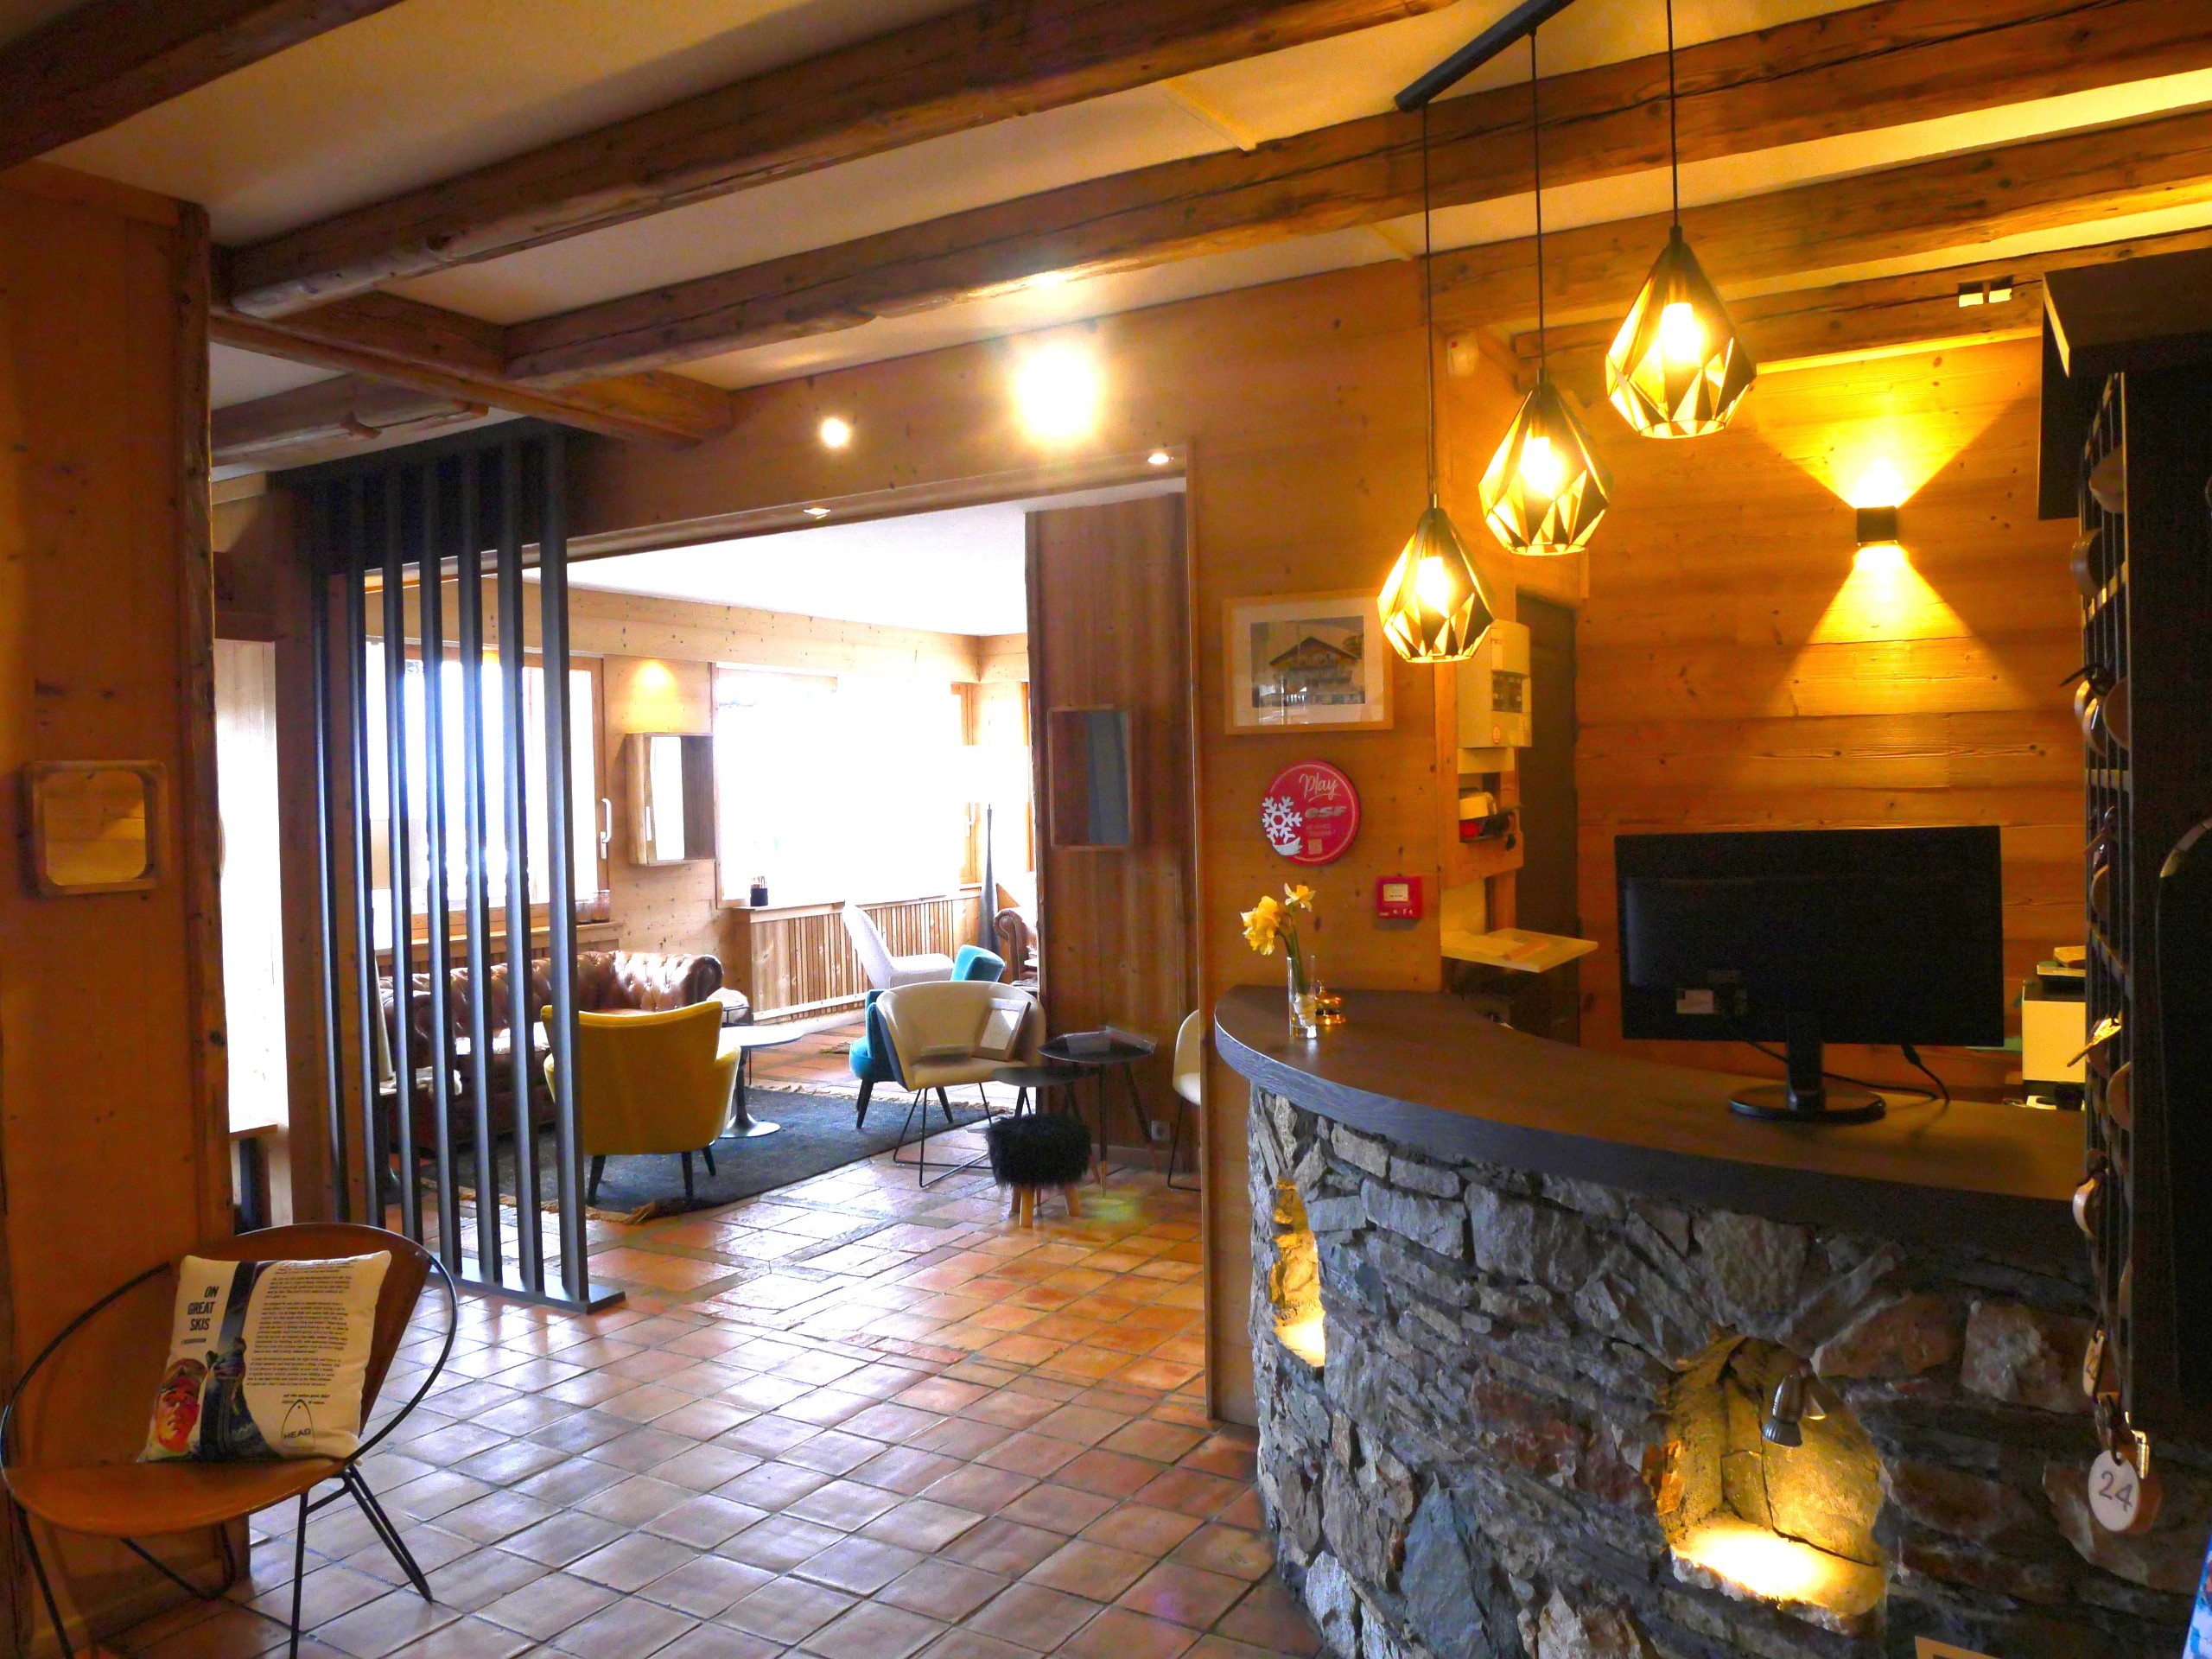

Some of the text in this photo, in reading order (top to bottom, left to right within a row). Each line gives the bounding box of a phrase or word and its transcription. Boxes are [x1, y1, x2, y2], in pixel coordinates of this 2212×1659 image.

[1299, 772, 1338, 801] Play
[204, 1286, 219, 1298] ON
[188, 1301, 215, 1315] GREAT
[189, 1318, 211, 1331] SKIS
[283, 1427, 311, 1440] HEAD
[2099, 1471, 2133, 1512] 24
